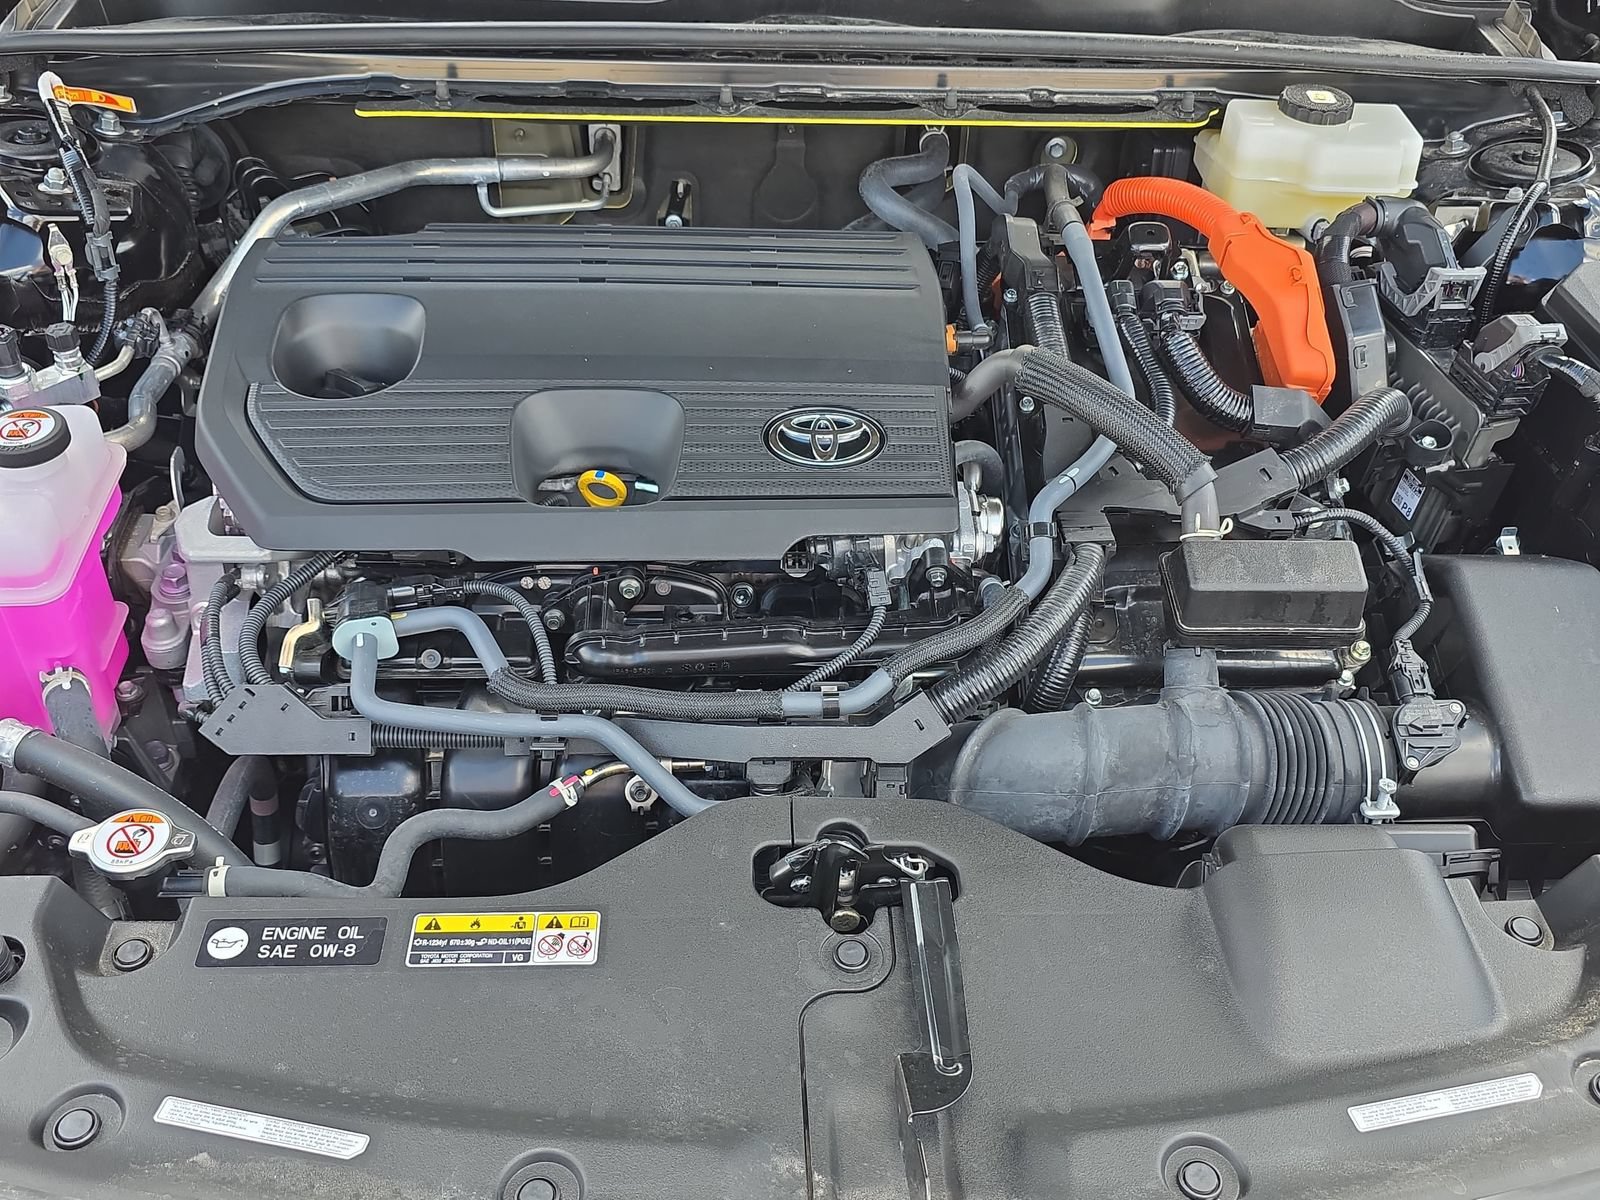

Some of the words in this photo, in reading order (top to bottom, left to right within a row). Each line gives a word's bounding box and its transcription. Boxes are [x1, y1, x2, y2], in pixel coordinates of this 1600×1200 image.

[1401, 502, 1412, 517] P8
[261, 926, 327, 940] ENGINE
[337, 926, 364, 939] OIL
[257, 944, 298, 959] SAE
[309, 943, 357, 958] 0W-8
[511, 953, 524, 962] VG
